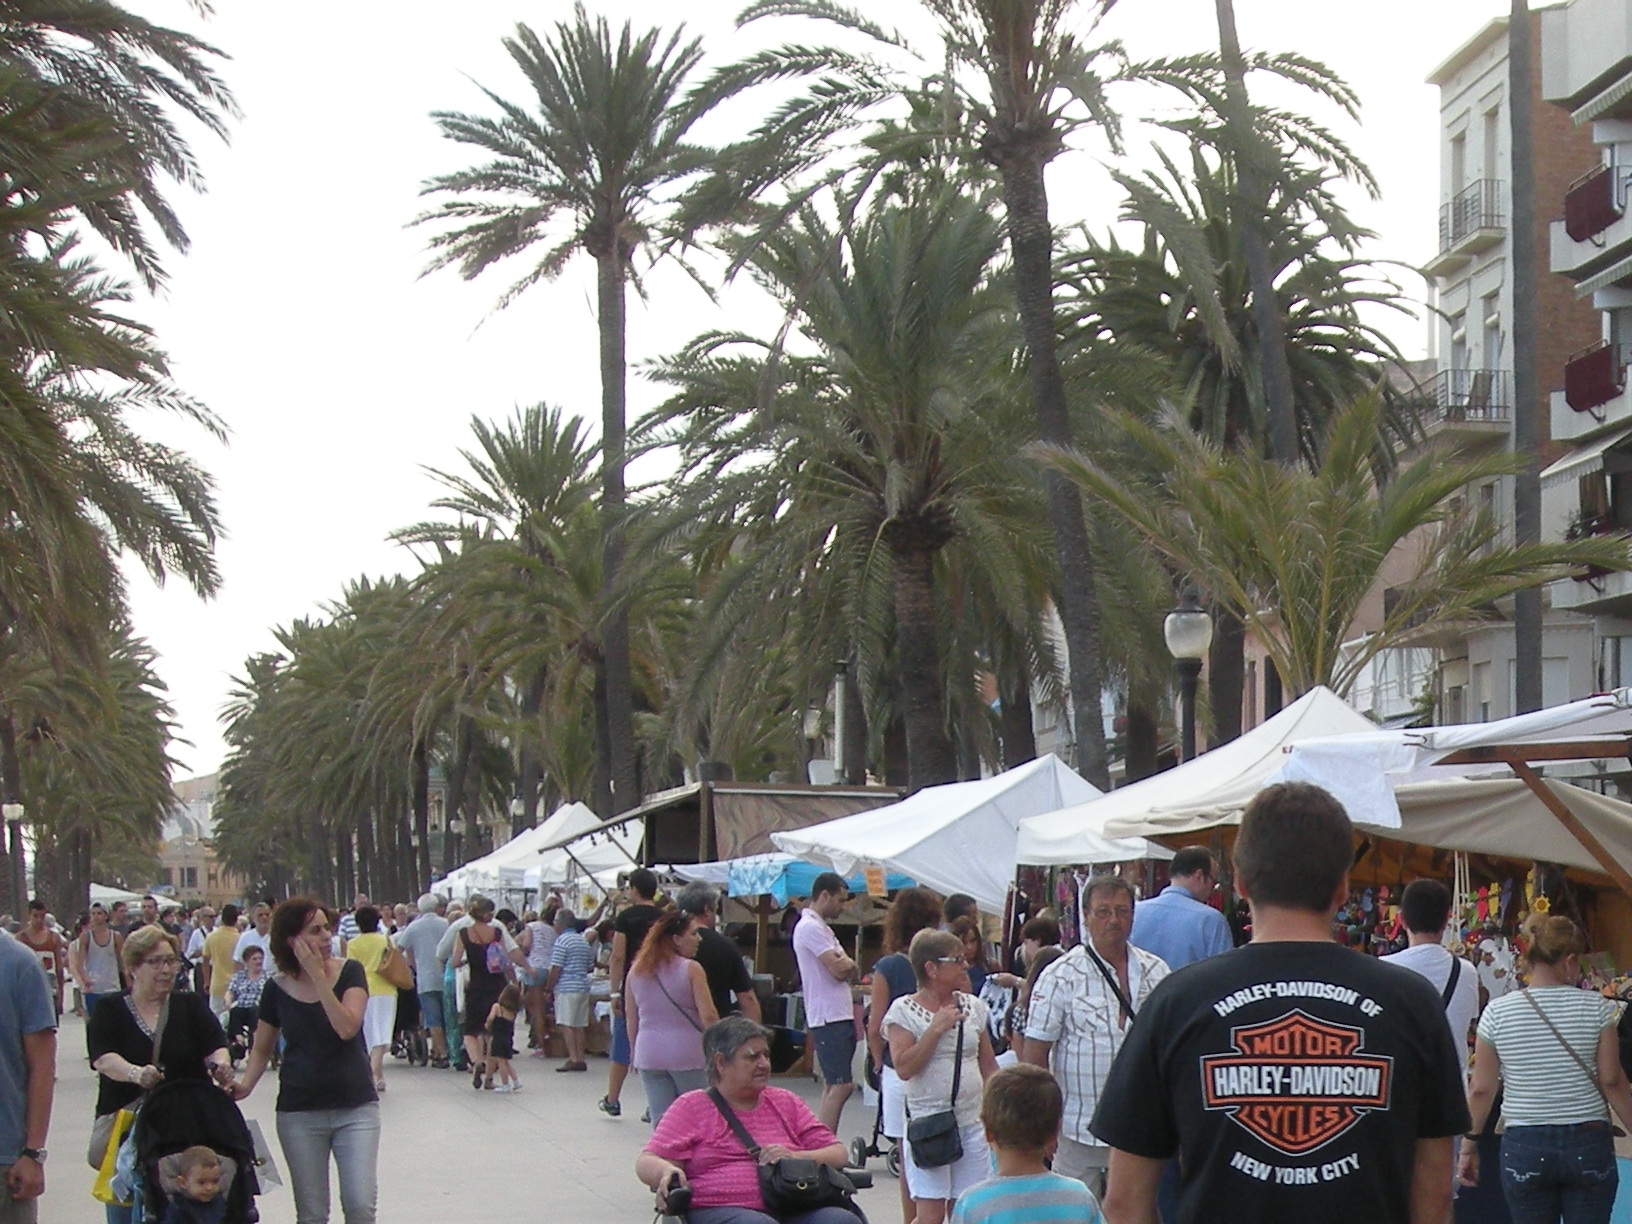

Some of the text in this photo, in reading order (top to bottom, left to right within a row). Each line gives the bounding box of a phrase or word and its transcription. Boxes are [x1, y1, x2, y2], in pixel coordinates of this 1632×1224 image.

[1213, 981, 1383, 1018] HARLEY-DAVIDSON OF
[1253, 1024, 1342, 1056] MOTOR
[1214, 1065, 1381, 1097] HARLEY-DAVIDSON
[1253, 1105, 1340, 1142] CYCLES
[1230, 1151, 1361, 1184] NEW YORK CITY
